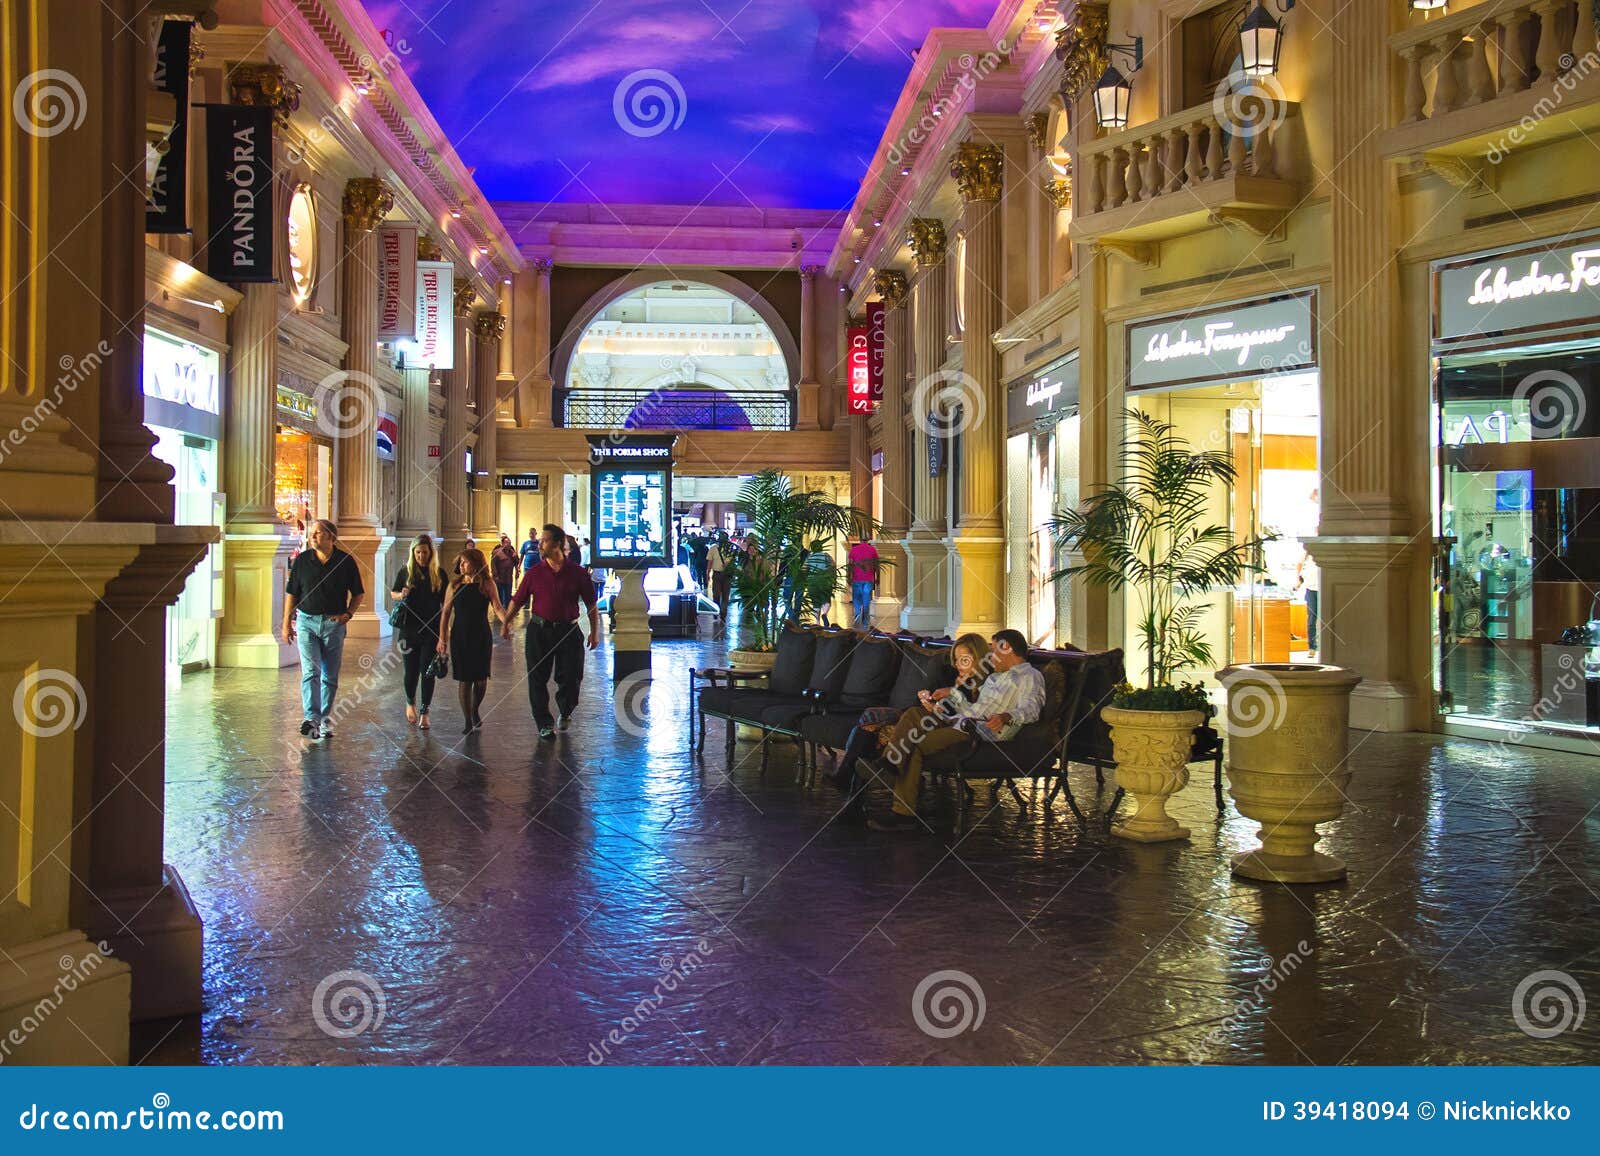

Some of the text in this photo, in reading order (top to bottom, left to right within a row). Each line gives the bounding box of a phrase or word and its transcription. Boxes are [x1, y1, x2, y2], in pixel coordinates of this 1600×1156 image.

[229, 126, 255, 266] PANDORA
[380, 232, 399, 331] TRUE RELIGION
[423, 272, 437, 301] TRUE
[422, 305, 437, 358] RELIGION
[853, 335, 868, 409] GUESS
[593, 448, 669, 457] THE FORUM SHOPS
[504, 478, 516, 486] PAL
